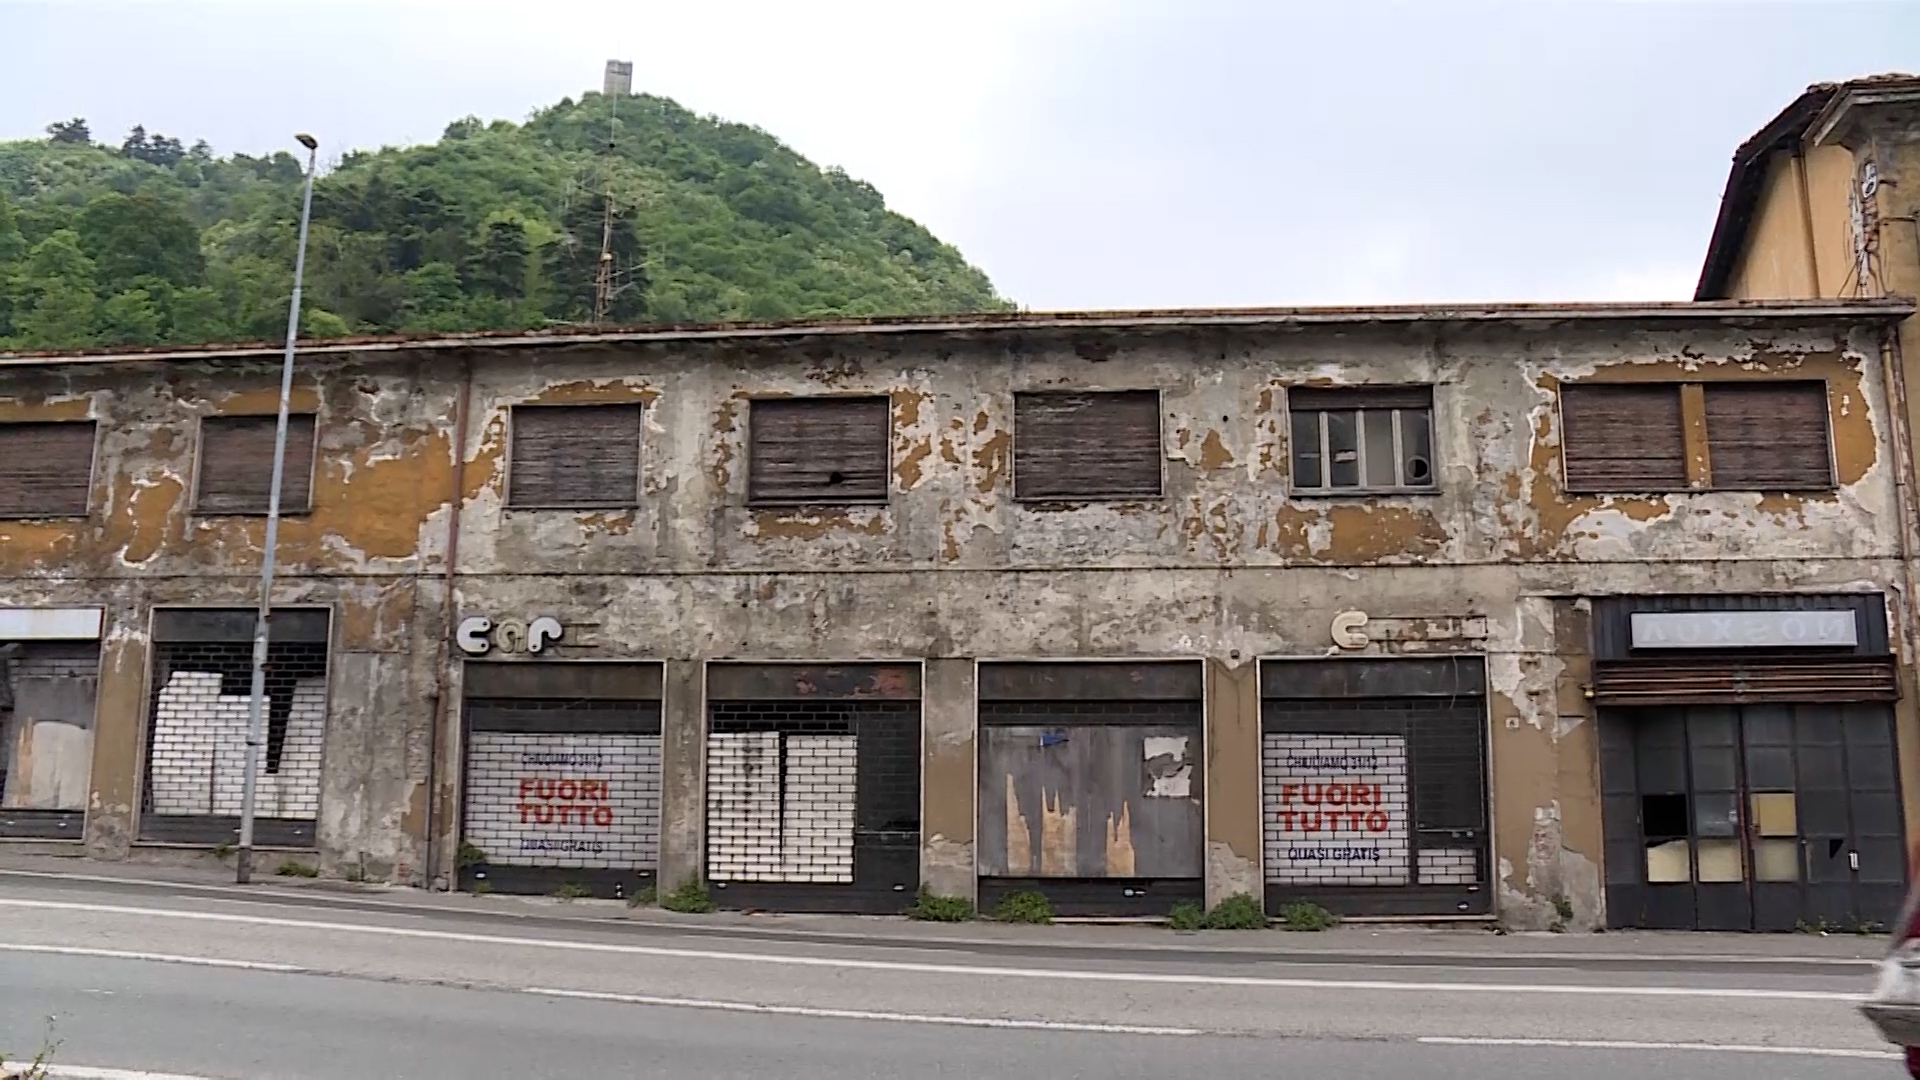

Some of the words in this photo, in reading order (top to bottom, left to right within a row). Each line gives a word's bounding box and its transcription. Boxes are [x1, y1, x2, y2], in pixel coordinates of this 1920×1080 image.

[519, 779, 608, 800] FUORI
[1282, 783, 1381, 806] FUORI
[517, 804, 613, 827] TUTTO
[1276, 811, 1389, 833] TUTTO
[1287, 847, 1328, 861] QUASI
[1332, 847, 1381, 862] GRATIS
